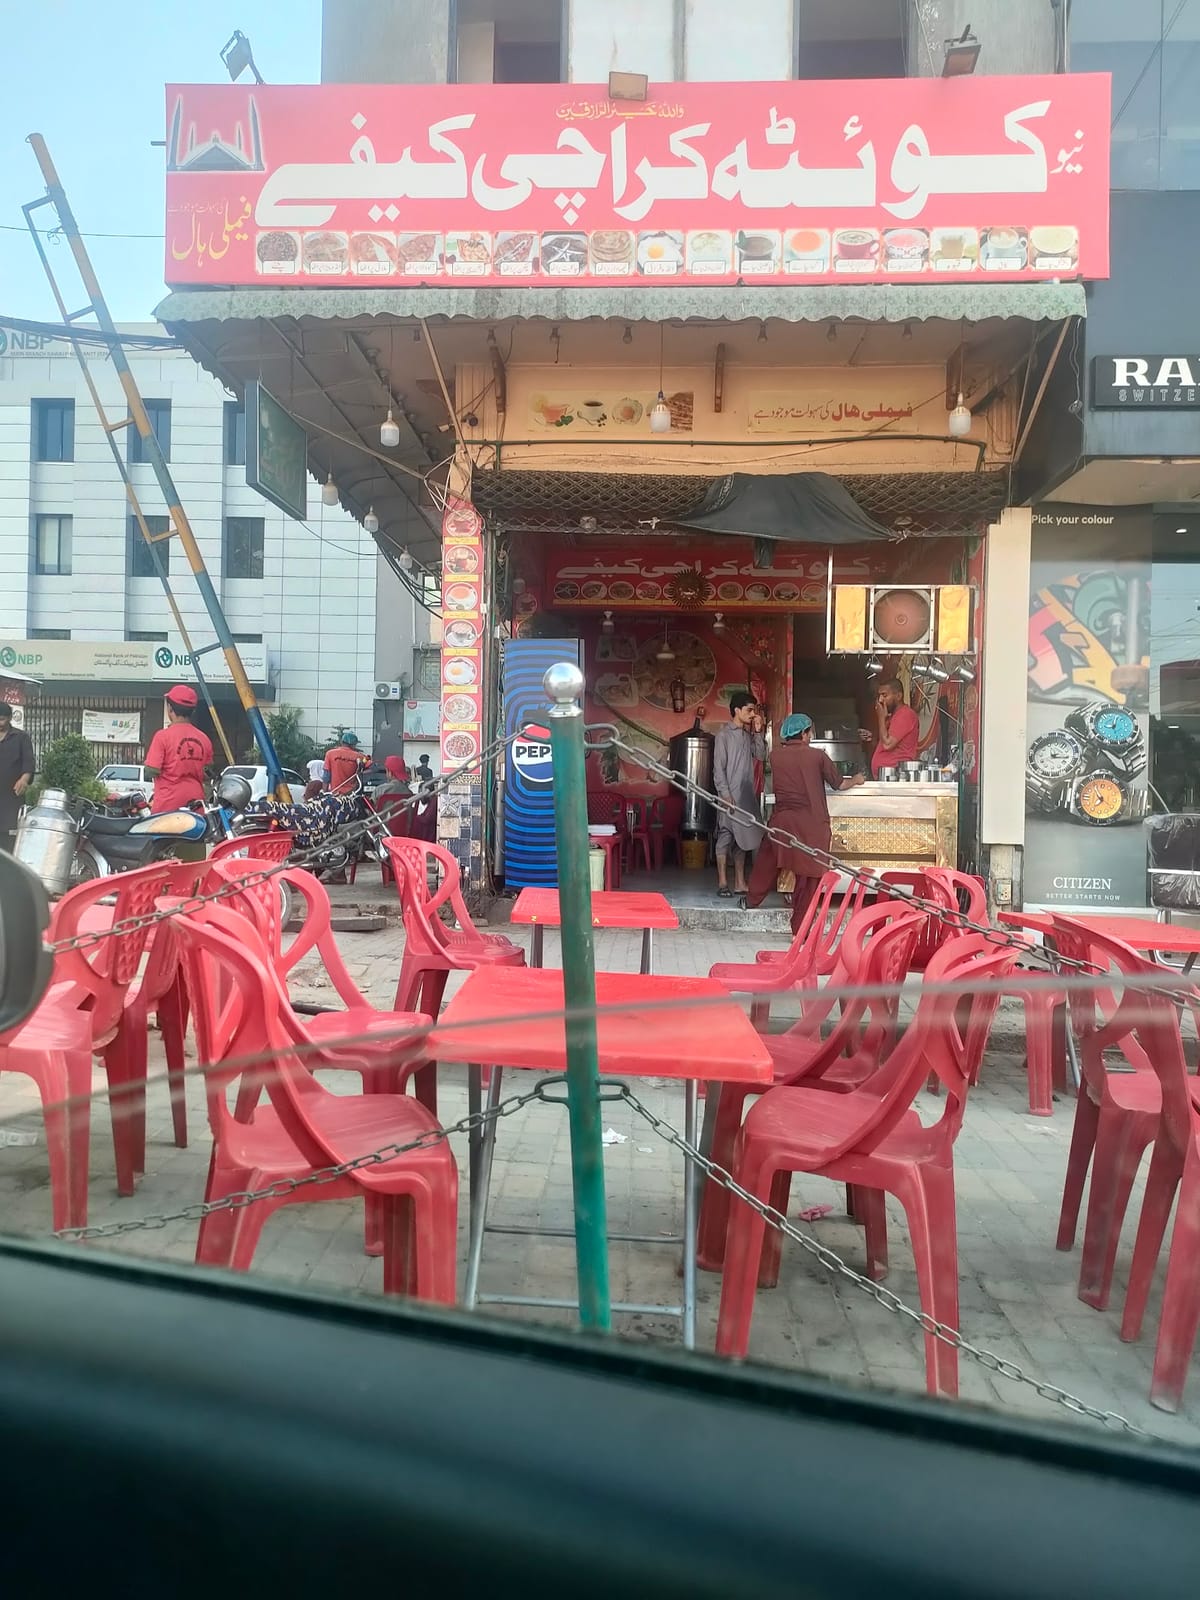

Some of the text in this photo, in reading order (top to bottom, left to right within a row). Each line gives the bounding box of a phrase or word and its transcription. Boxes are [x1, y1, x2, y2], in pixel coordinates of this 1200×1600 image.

[254, 100, 1085, 227] نیو کوئٹہ کراچی کیفے
[1112, 358, 1200, 386] RA
[862, 402, 913, 421] فیملی
[1032, 514, 1114, 527] Pick your colour
[556, 558, 642, 578] کیفے
[18, 654, 42, 665] NBP
[516, 746, 552, 758] PEP
[1053, 876, 1112, 890] CITIZEN
